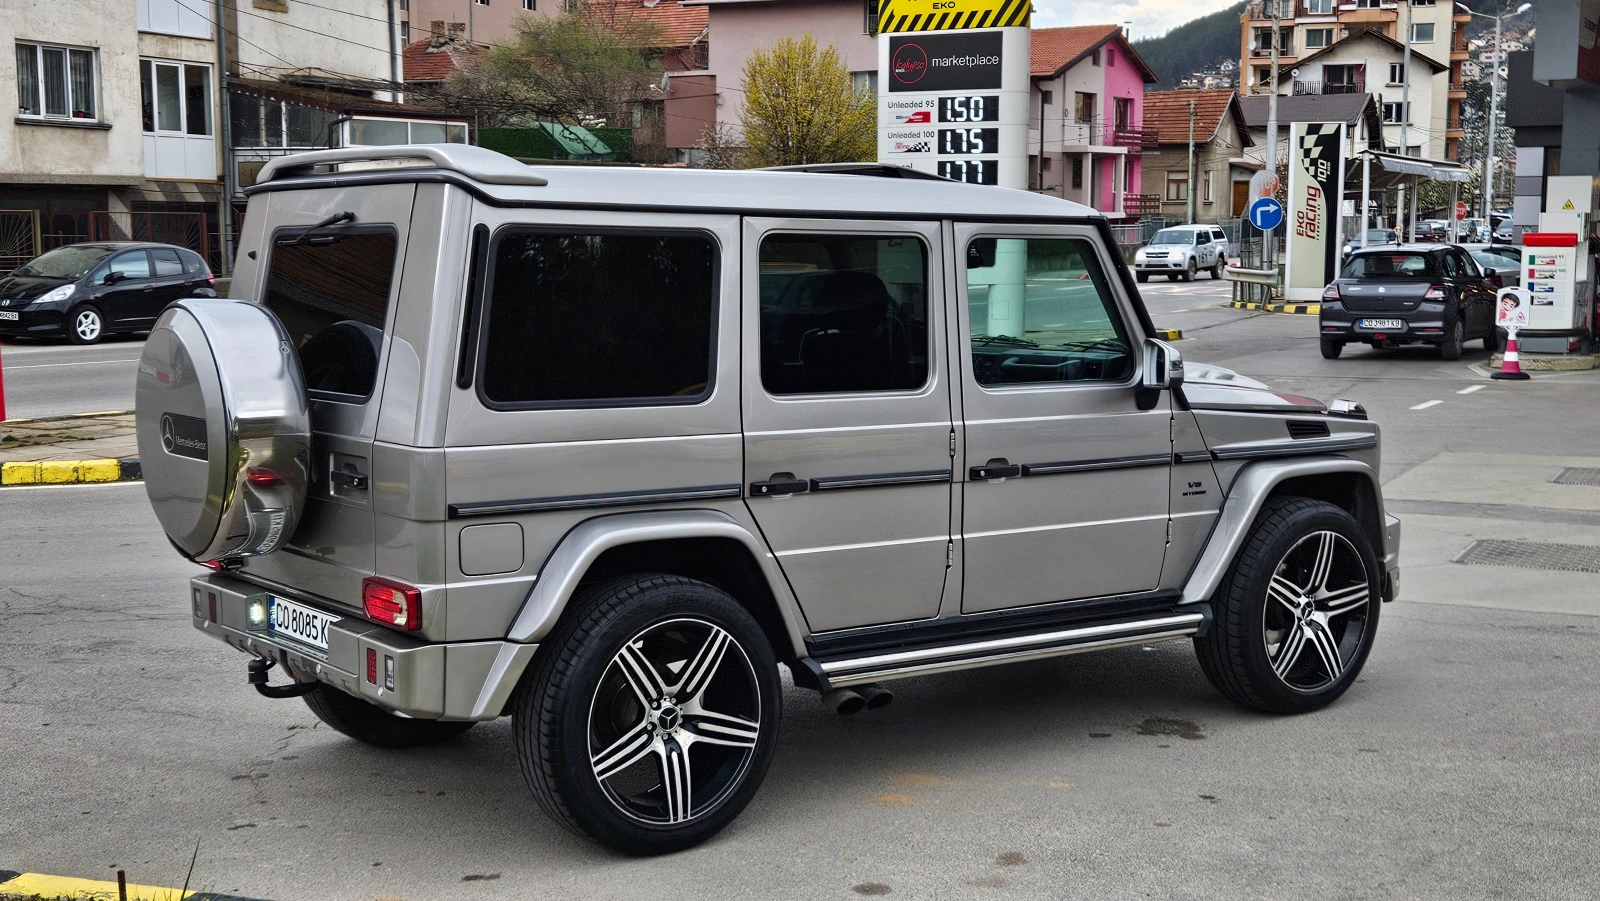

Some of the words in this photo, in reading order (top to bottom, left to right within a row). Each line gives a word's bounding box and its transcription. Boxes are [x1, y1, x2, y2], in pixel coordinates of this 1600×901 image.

[932, 1, 956, 10] EKO
[932, 53, 1000, 68] marketplace
[887, 100, 923, 109] Unleaded
[925, 100, 935, 108] 95
[946, 96, 984, 122] 1.50
[887, 131, 921, 139] Unleaded
[922, 130, 935, 138] 100
[945, 128, 983, 154] 1.75
[945, 160, 983, 183] 177
[1316, 158, 1327, 183] 100
[1296, 210, 1305, 237] EKO
[1304, 185, 1321, 240] racing
[175, 435, 206, 450] Mercedes-Benz
[276, 602, 290, 630] CO
[291, 608, 319, 641] 8085
